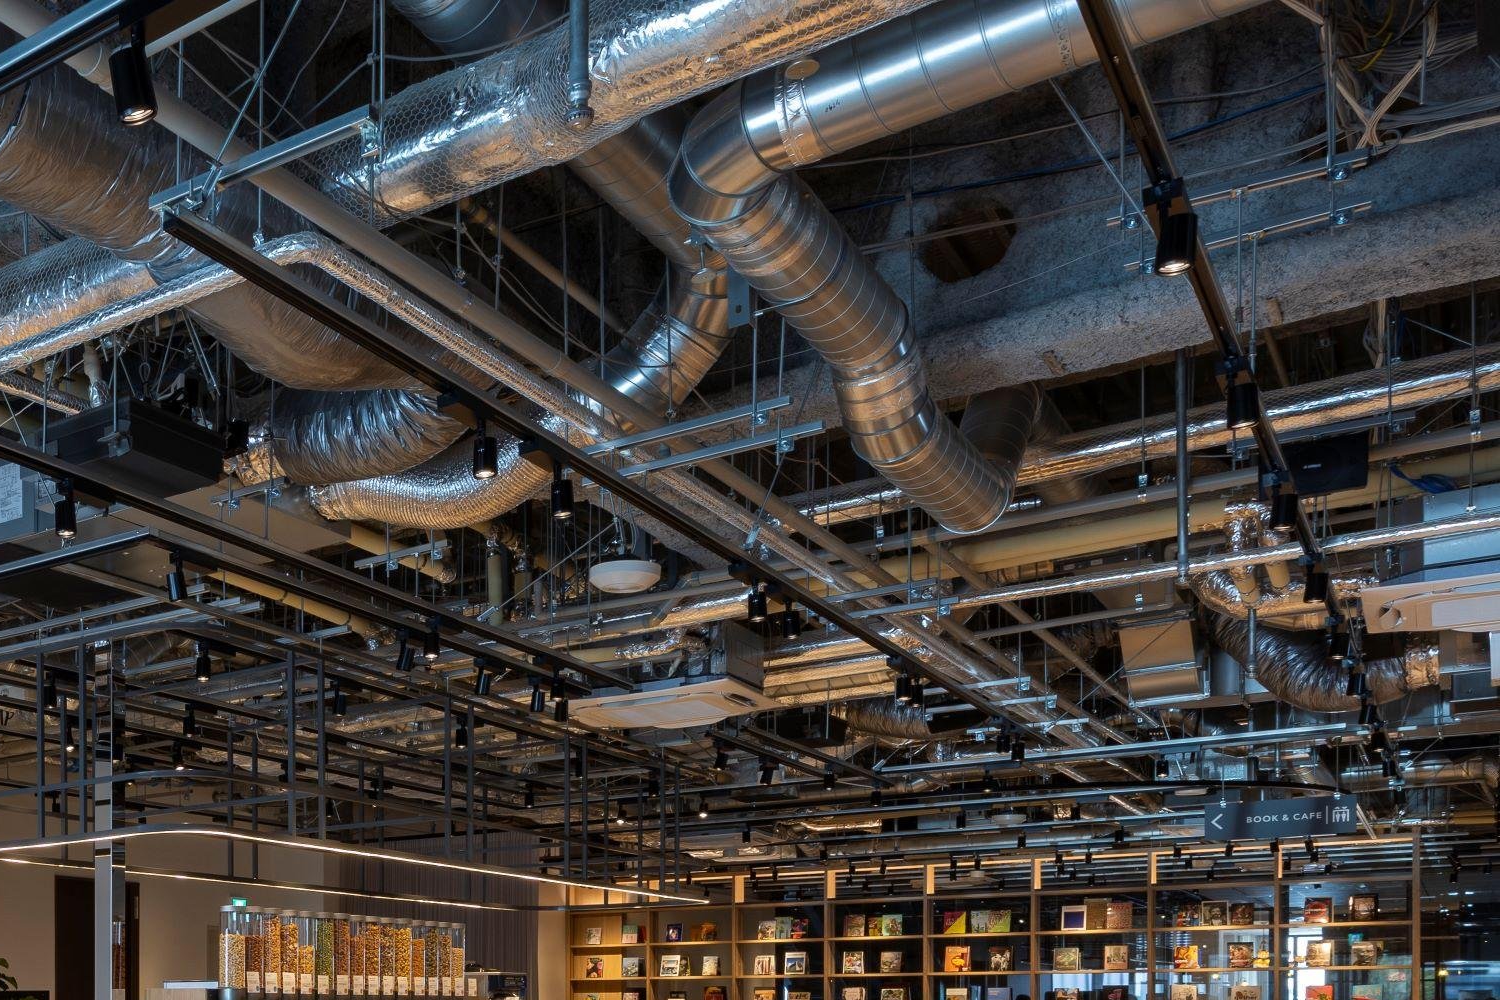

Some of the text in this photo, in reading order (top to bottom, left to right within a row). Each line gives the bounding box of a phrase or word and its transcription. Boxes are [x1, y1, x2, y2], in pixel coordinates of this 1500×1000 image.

[1246, 811, 1322, 824] BOOK & CAFE
